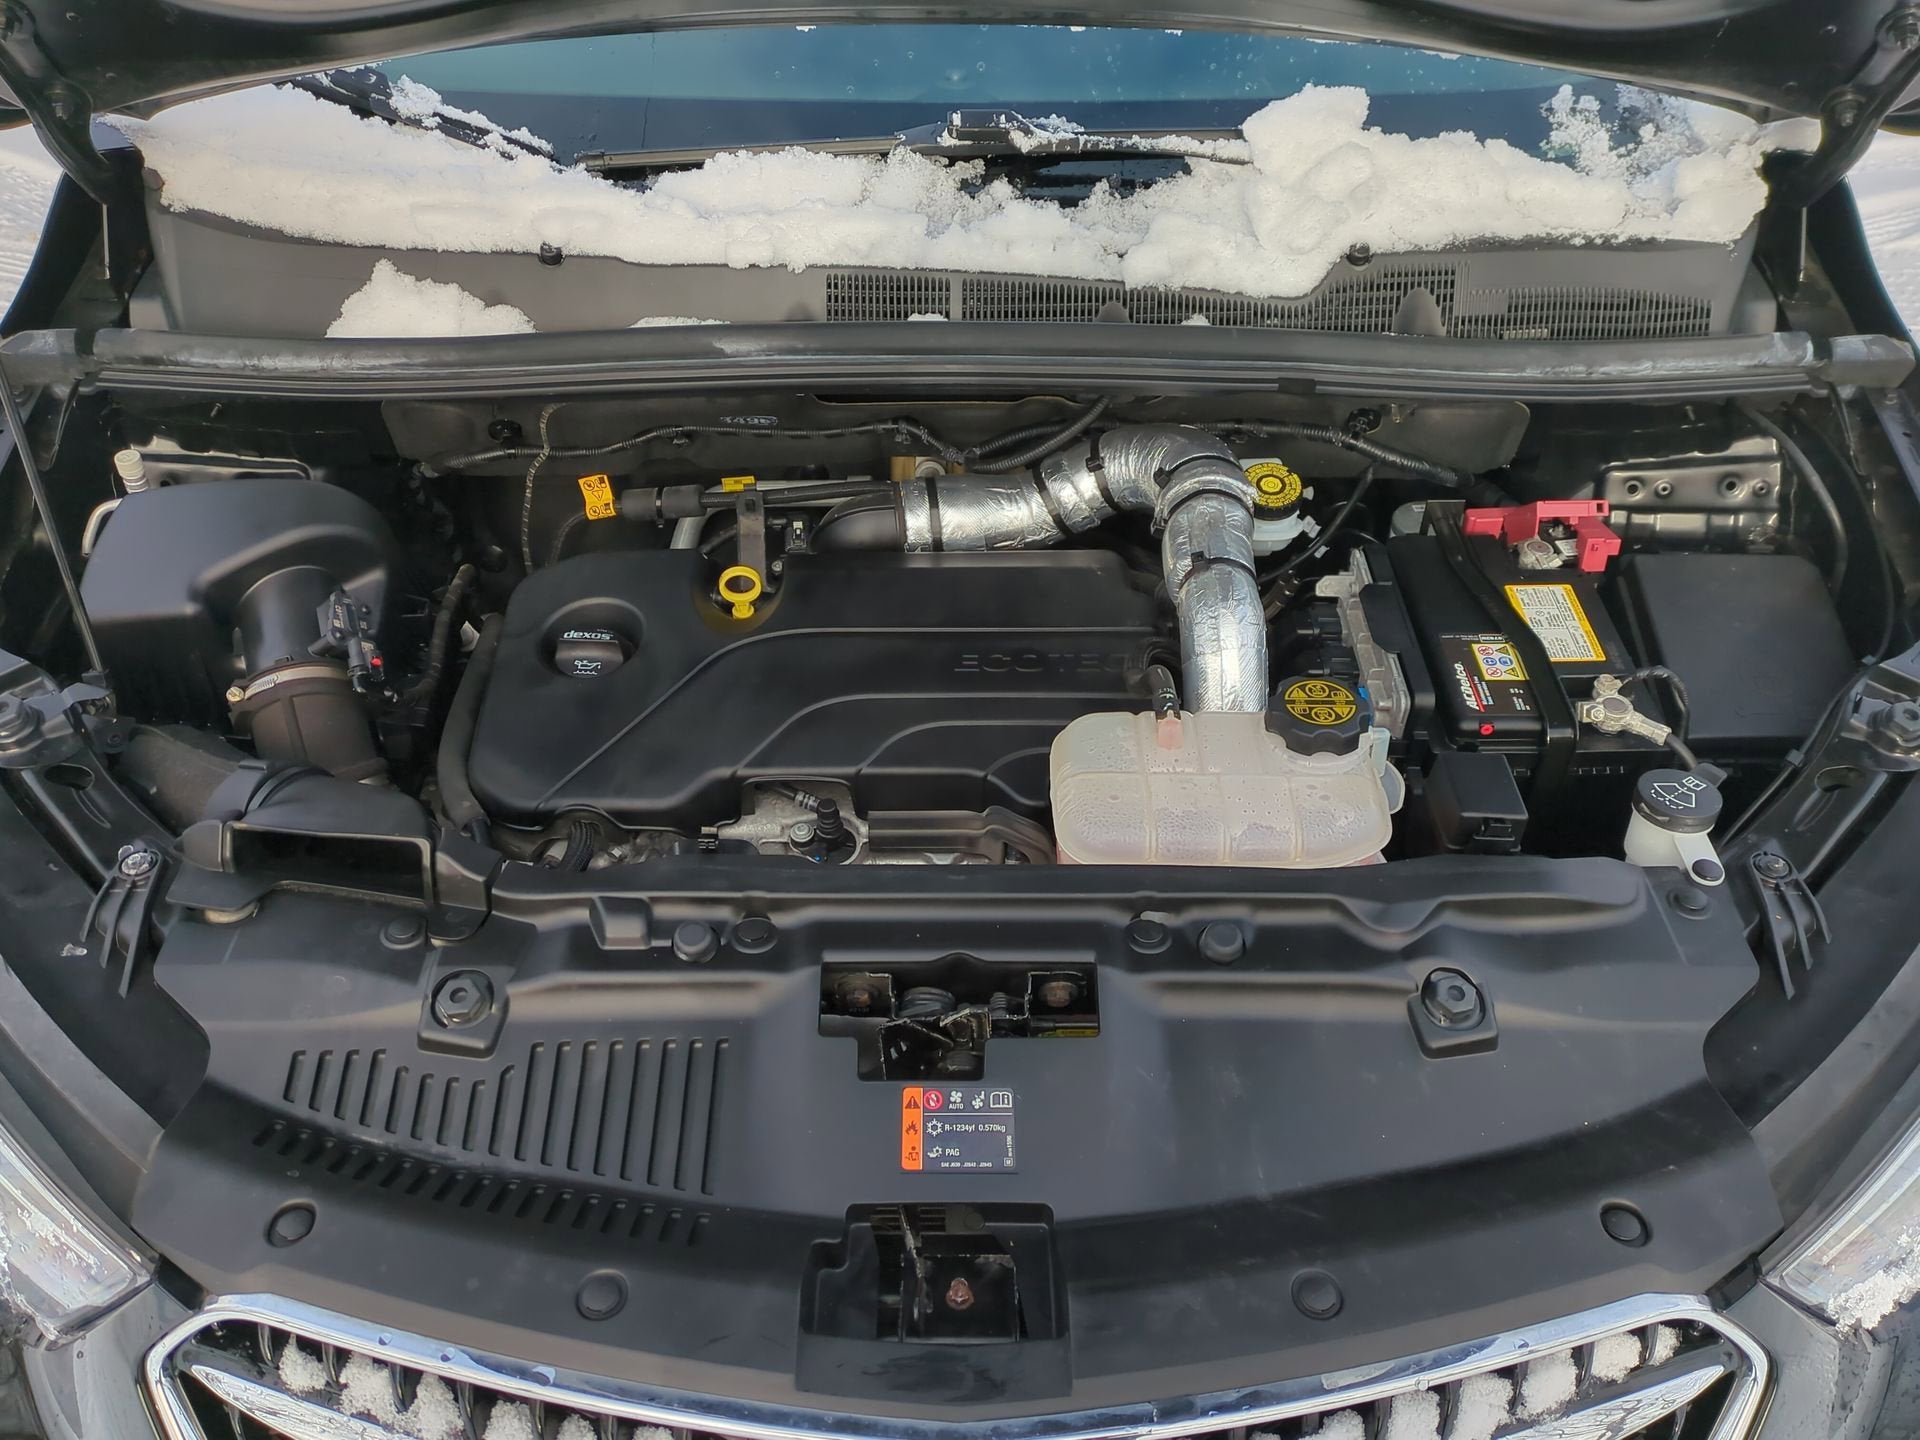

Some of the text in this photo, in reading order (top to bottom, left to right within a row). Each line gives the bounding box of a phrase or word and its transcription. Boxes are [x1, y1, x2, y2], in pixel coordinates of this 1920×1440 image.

[563, 630, 611, 640] dexos
[1454, 662, 1480, 711] ACDelco
[944, 1124, 1006, 1132] R-1234yf 0.570kg
[945, 1148, 960, 1156] PAG
